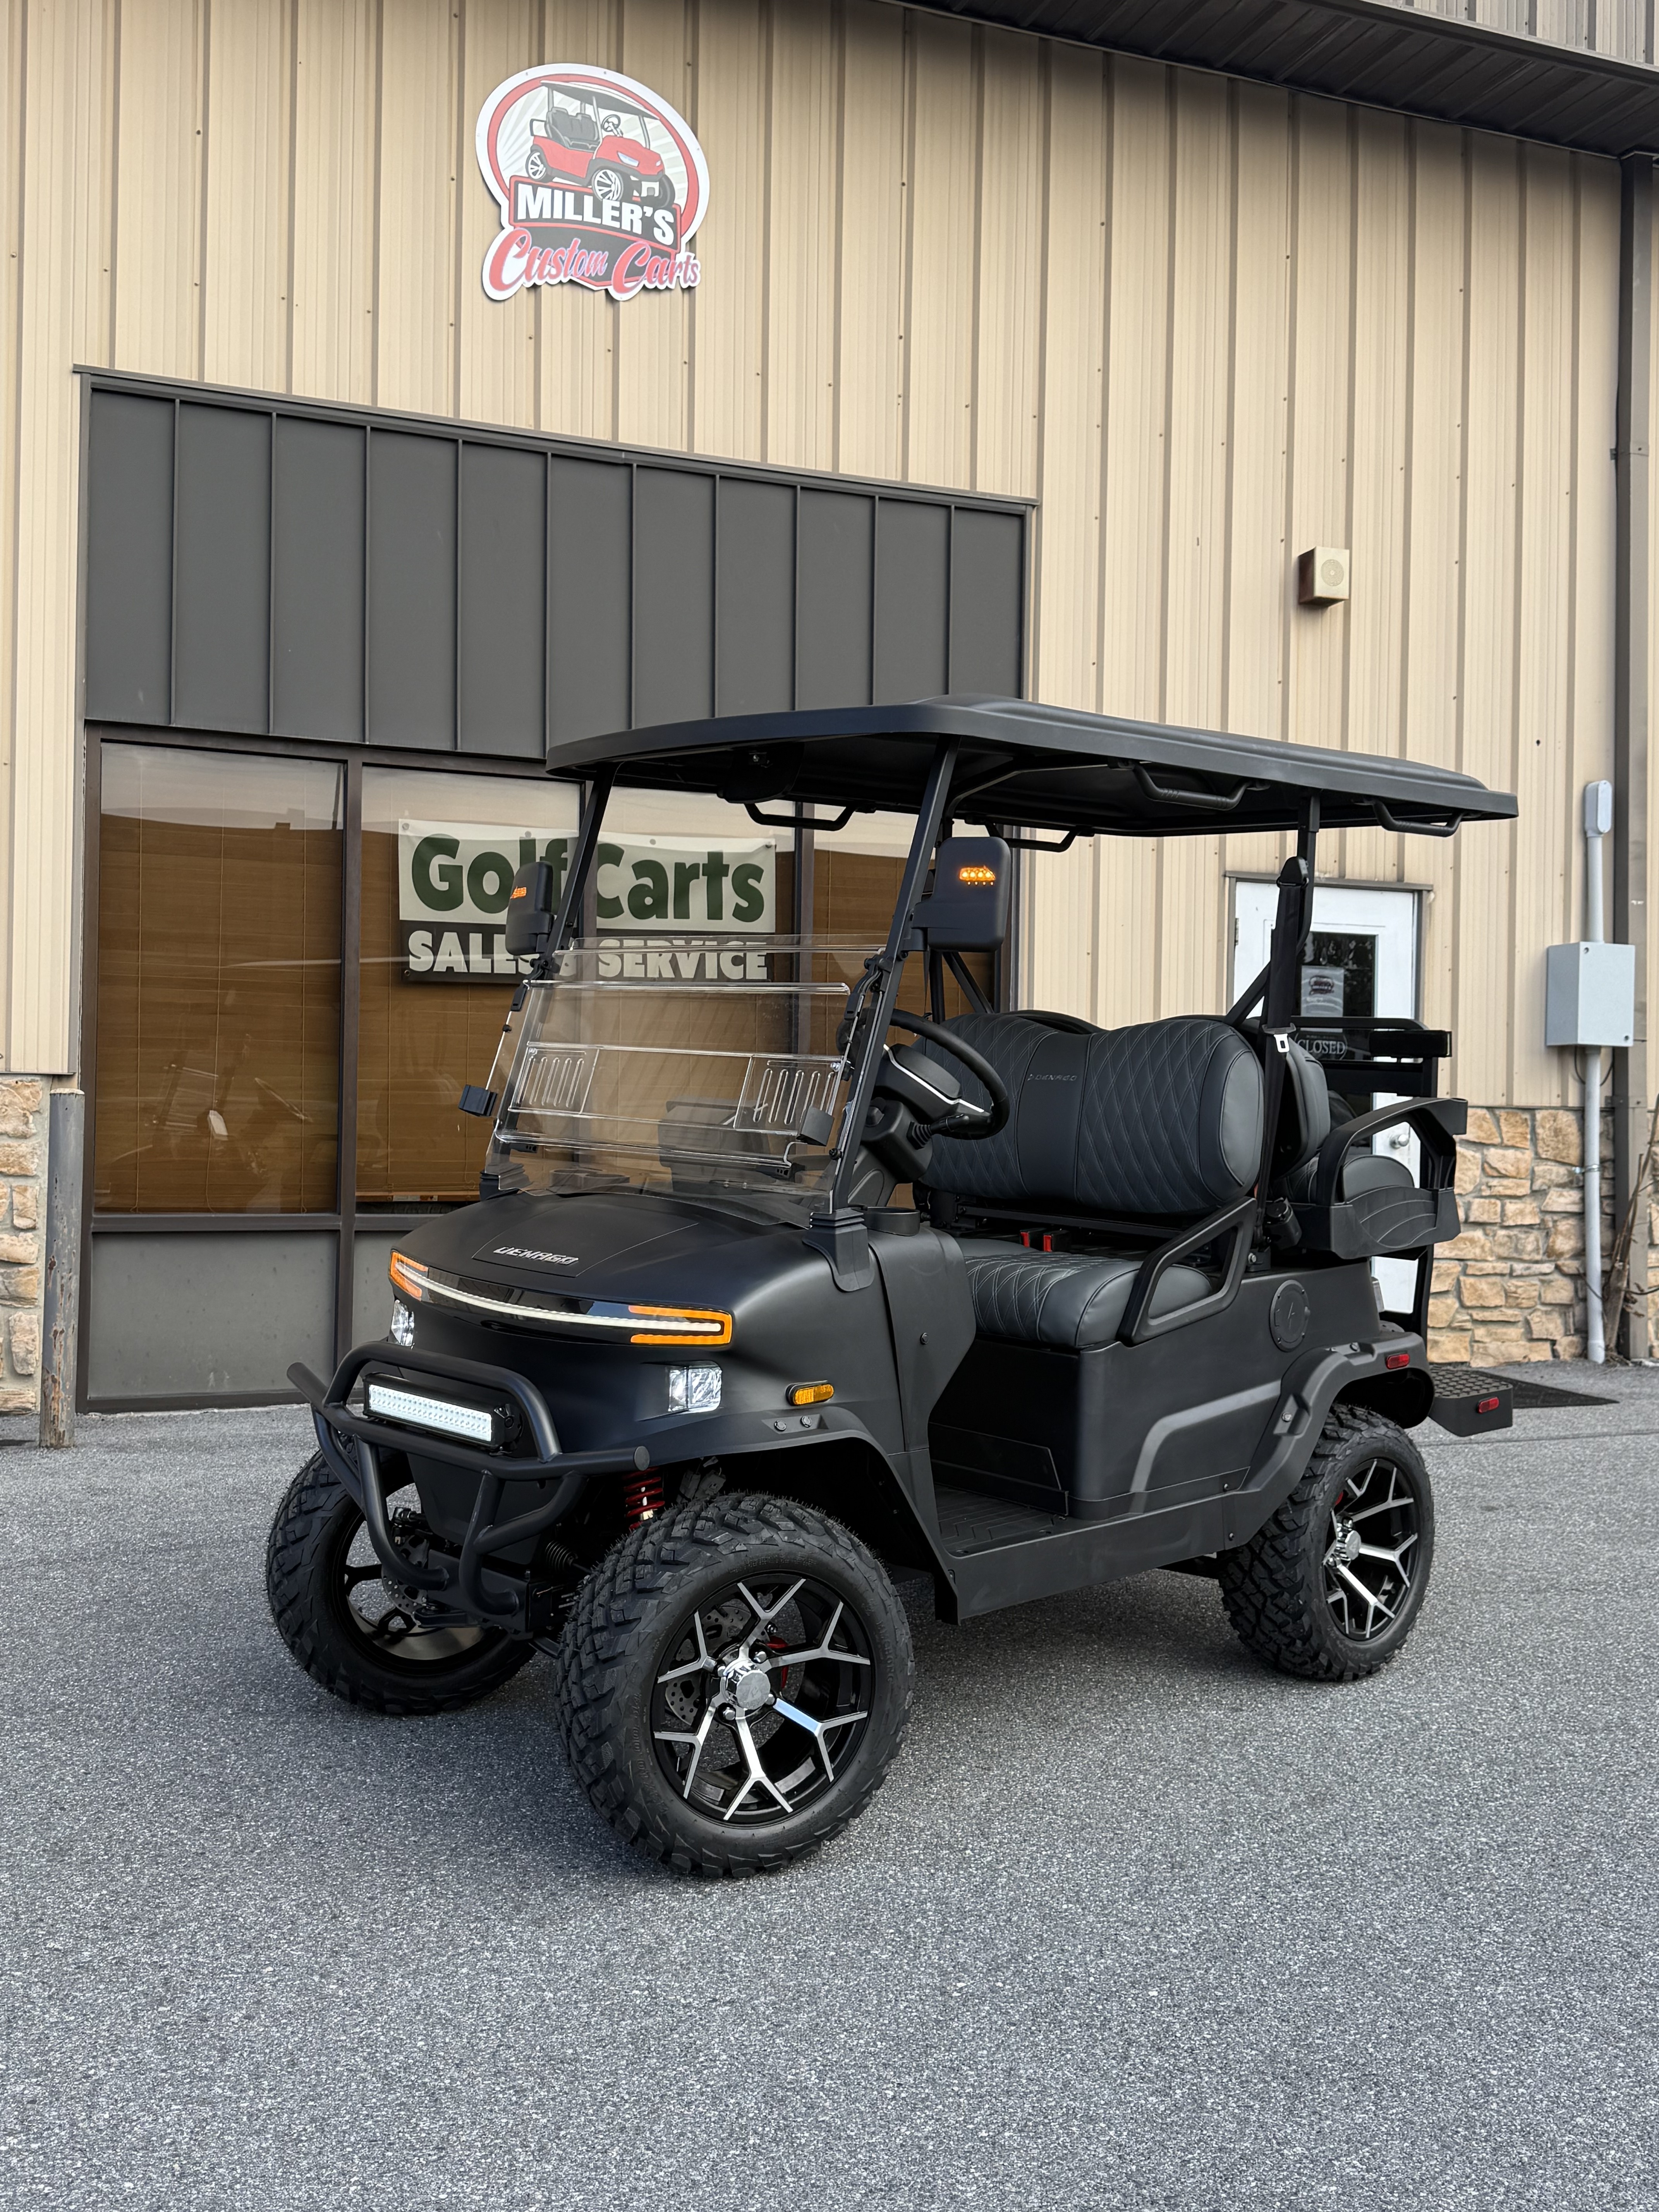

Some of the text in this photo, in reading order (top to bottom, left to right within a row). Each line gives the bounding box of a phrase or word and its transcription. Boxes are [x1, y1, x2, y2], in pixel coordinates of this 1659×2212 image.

[517, 183, 674, 246] MILLER'S
[489, 228, 698, 294] Custom Carts
[598, 939, 768, 980] SERVICE
[493, 1247, 579, 1265] DENAGO
